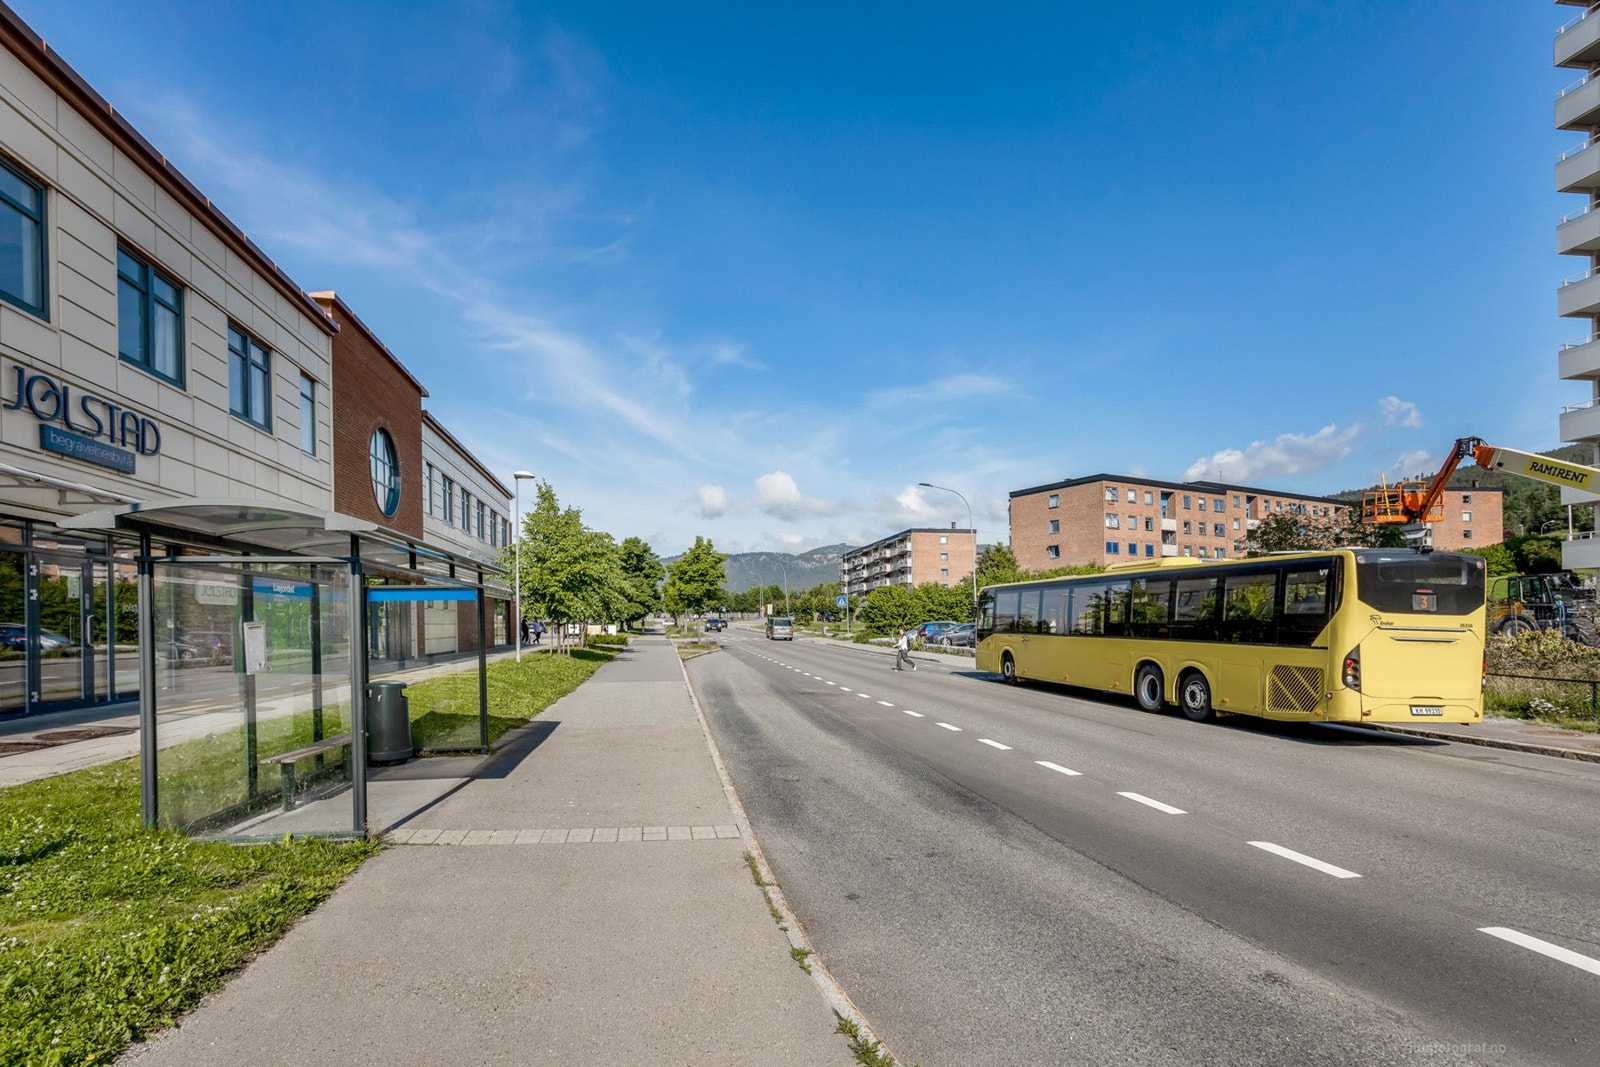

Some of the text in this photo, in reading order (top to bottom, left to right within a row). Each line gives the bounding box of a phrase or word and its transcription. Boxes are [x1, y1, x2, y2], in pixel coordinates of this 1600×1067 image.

[50, 430, 133, 467] begravelsesbyrå
[1530, 462, 1588, 483] RAMIRENT
[1420, 595, 1429, 610] 3
